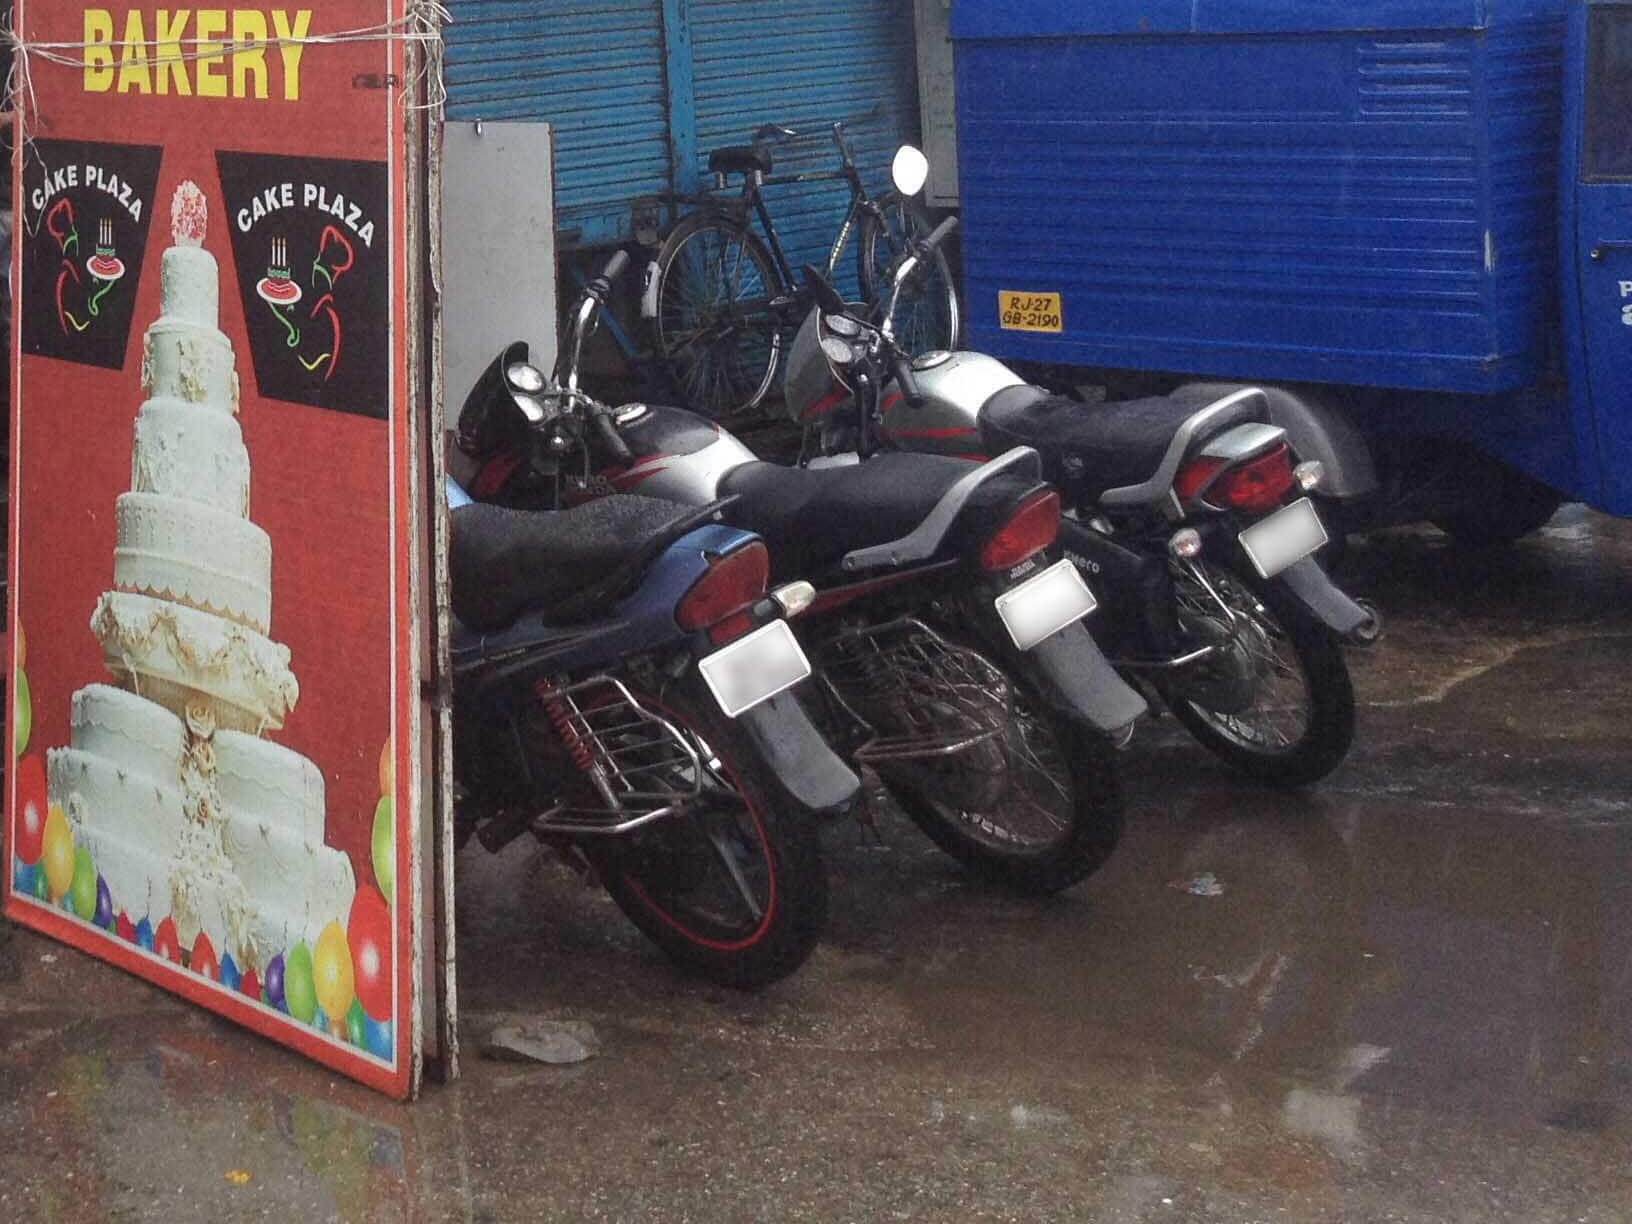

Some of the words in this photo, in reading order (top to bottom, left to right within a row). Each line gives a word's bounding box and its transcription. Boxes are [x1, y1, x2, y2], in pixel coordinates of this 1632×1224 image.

[83, 9, 313, 101] BAKERY
[31, 164, 78, 211] CAKE
[85, 164, 143, 224] PLAZA
[236, 182, 295, 233] CAKE
[303, 182, 376, 249] PLAZA
[1010, 296, 1052, 312] RJ-27
